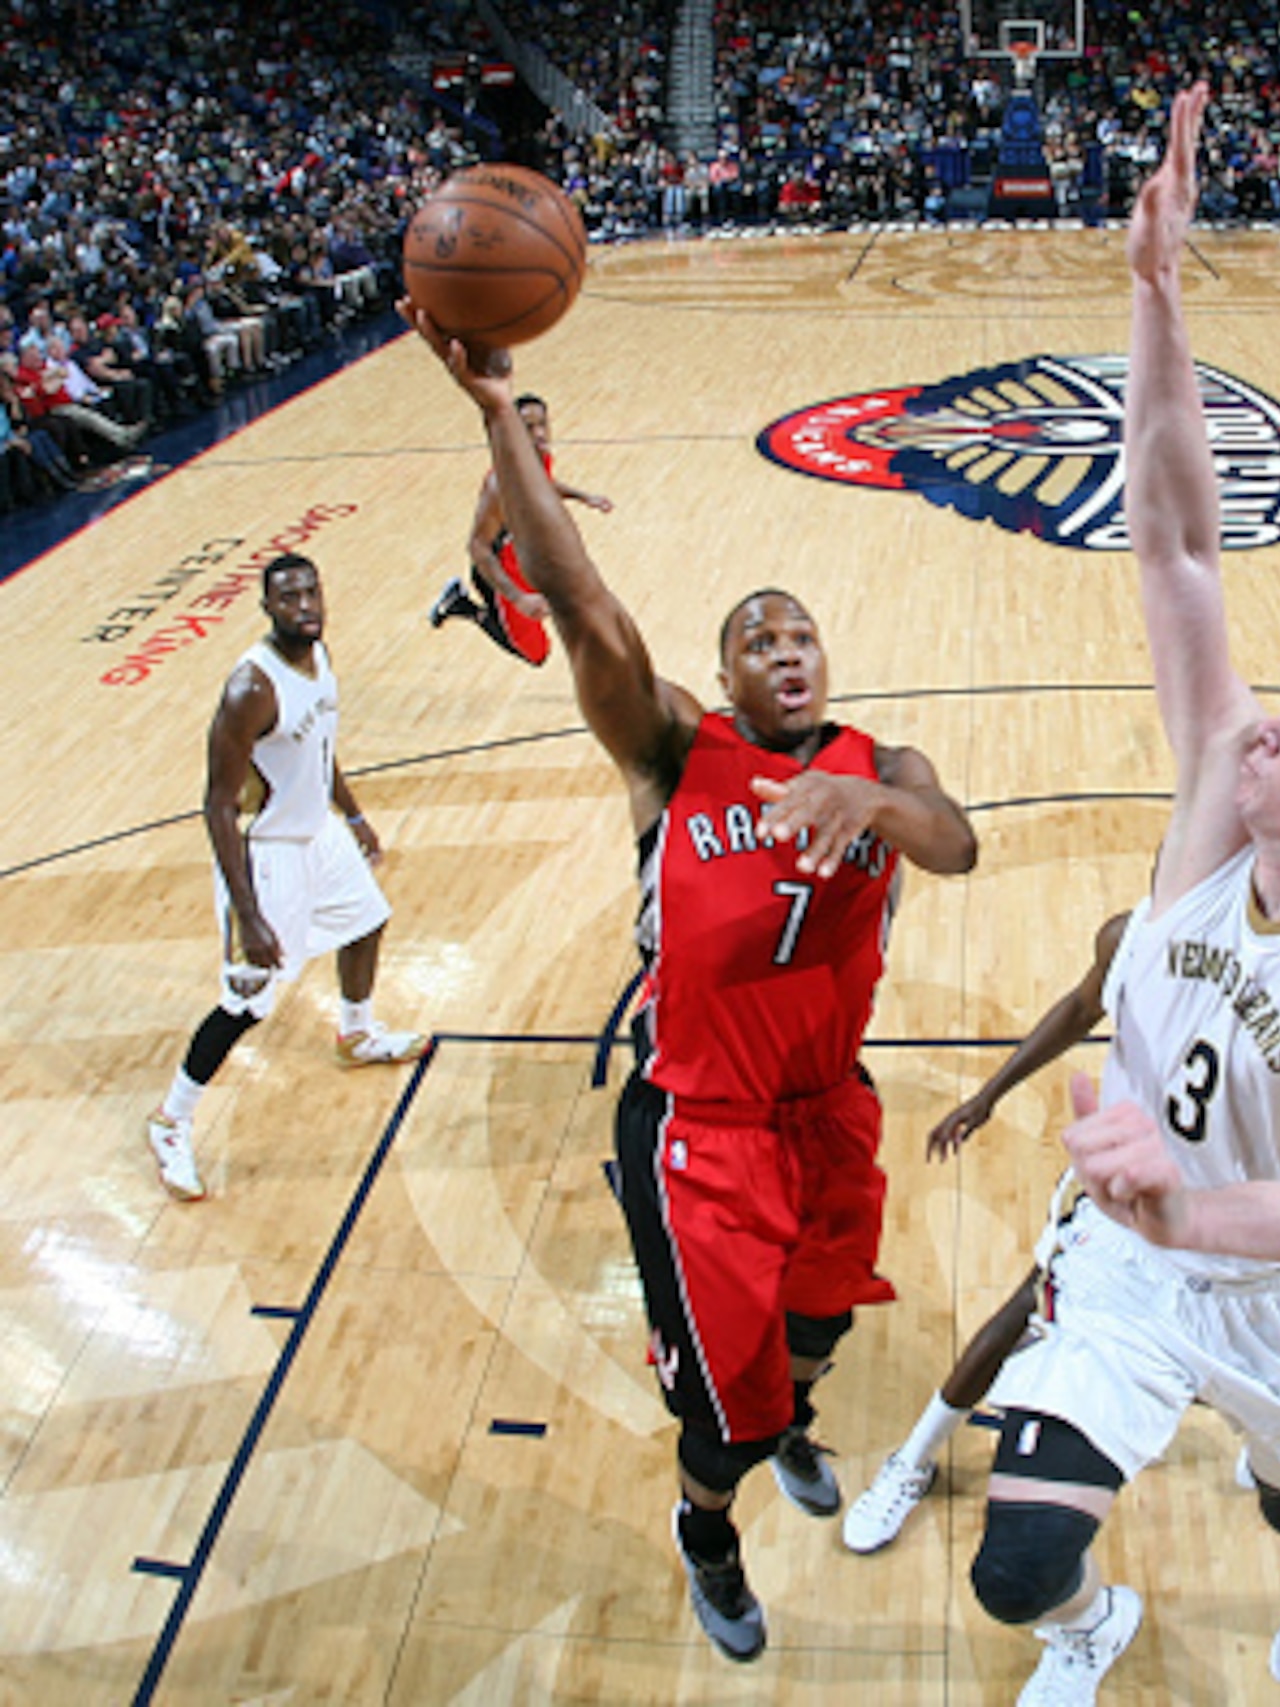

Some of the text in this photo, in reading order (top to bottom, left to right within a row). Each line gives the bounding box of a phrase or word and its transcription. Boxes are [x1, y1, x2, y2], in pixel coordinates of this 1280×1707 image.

[80, 538, 246, 642] CENTER
[772, 881, 814, 965] 7
[1167, 1038, 1220, 1143] 3
